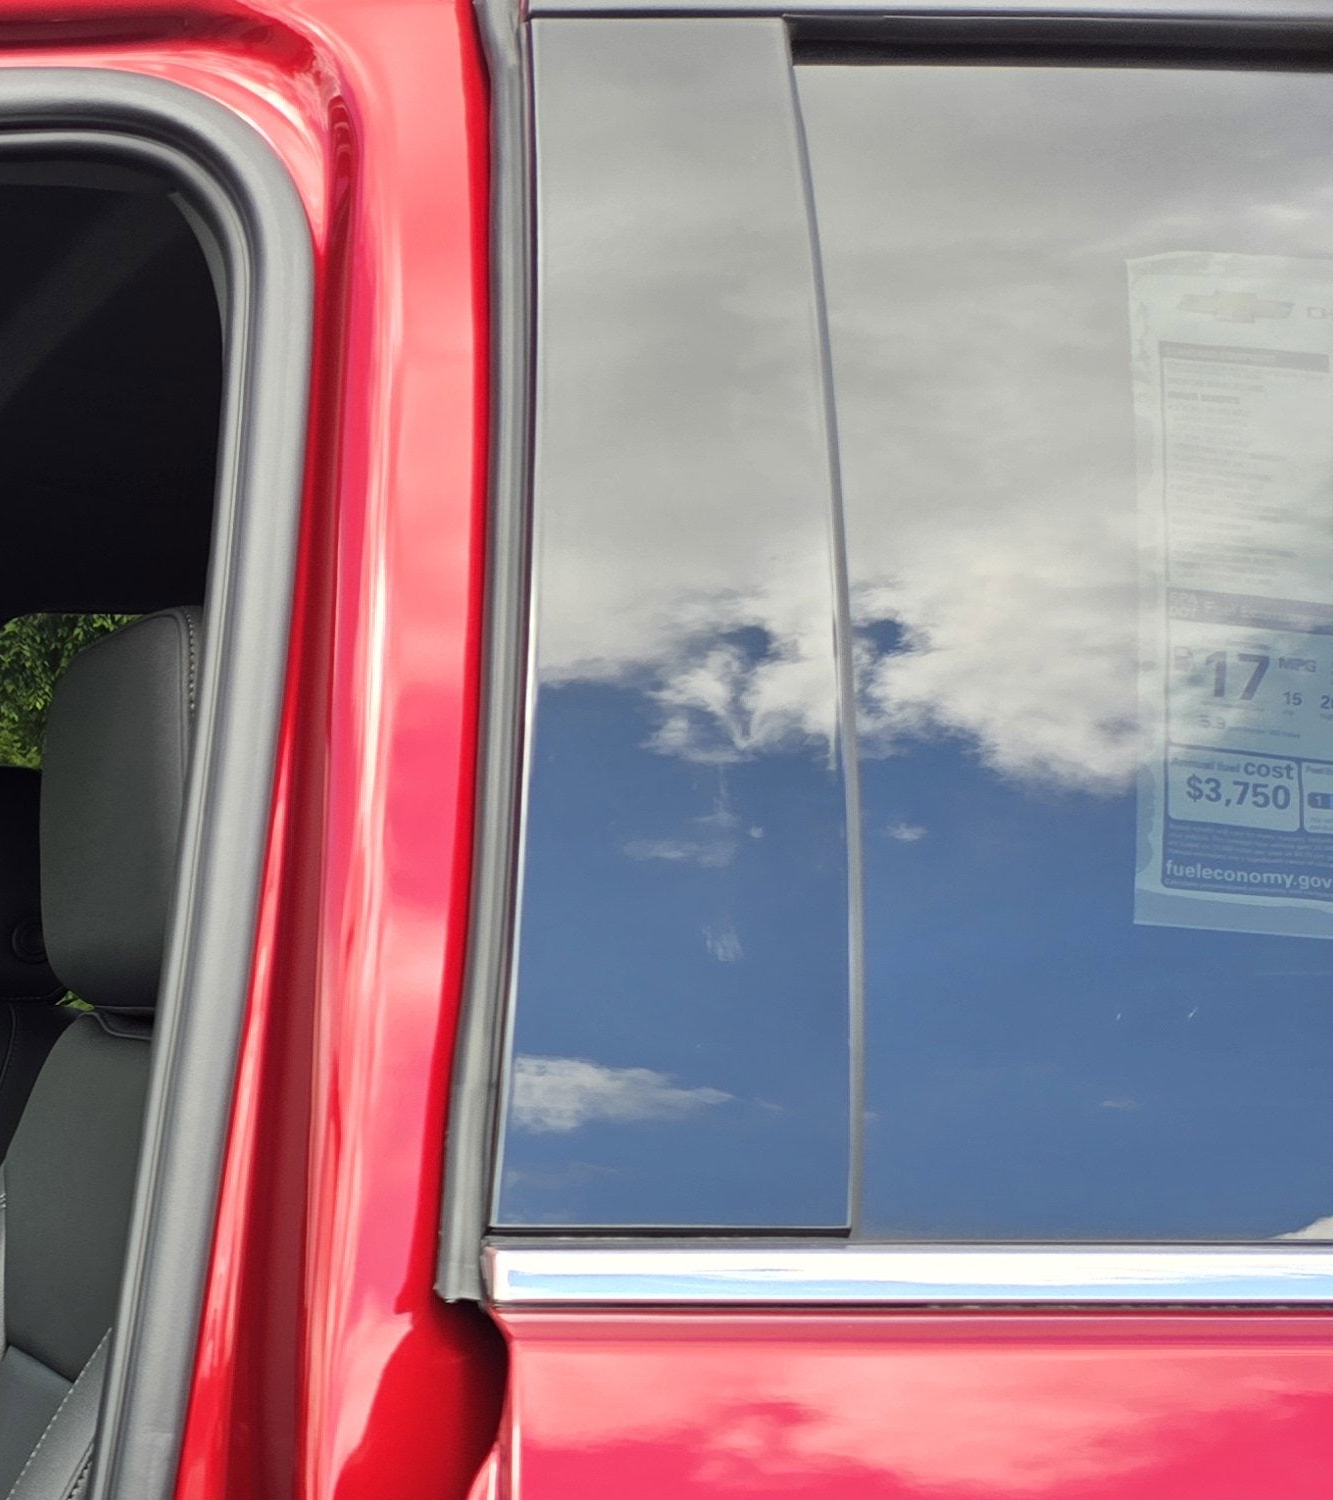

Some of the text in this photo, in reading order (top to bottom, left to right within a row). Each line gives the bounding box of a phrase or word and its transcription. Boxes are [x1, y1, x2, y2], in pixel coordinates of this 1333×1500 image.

[1205, 650, 1317, 701] 17 MPG
[1283, 691, 1303, 706] 15
[1320, 695, 1333, 710] 2
[1244, 762, 1294, 780] cost
[1186, 773, 1291, 810] $3,750
[1165, 860, 1333, 890] fueleconomy.gov
